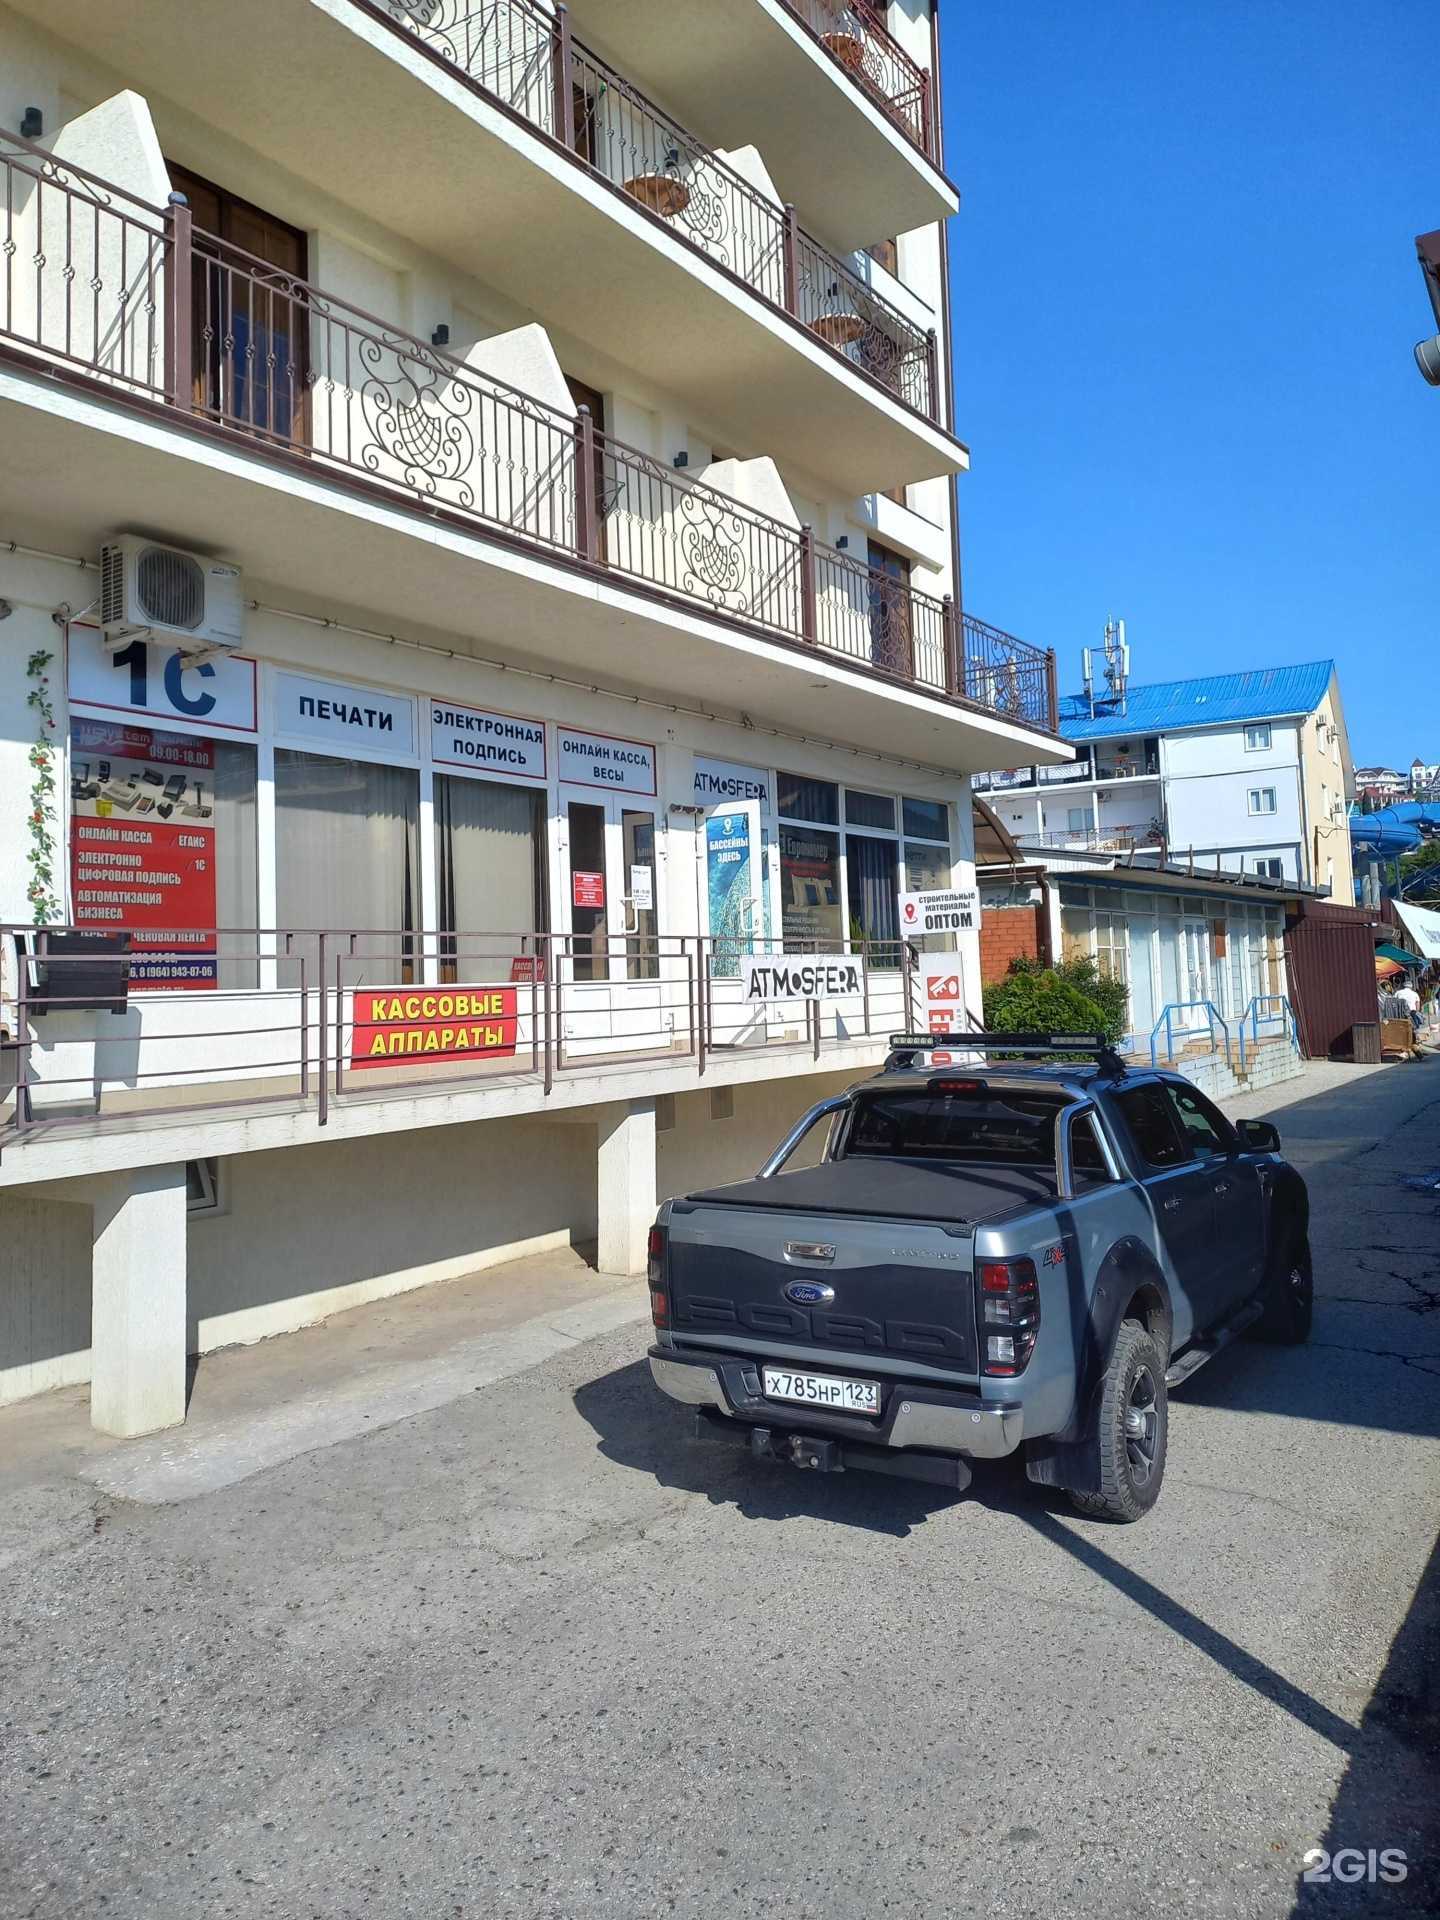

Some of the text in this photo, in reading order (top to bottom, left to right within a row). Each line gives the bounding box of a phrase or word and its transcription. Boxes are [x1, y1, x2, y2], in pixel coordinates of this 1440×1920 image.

[299, 696, 393, 731] ПЕЧАТИ
[433, 709, 543, 744] ЭЛЕКТРОННАЯ
[453, 739, 527, 765] ПОДПИСЬ
[563, 740, 651, 769] ОНЛАЙН КАССА,
[593, 766, 624, 782] ВЕСЫ
[79, 827, 153, 844] ОНЛАЙН КАССА
[178, 835, 206, 848] ЕГАИС
[709, 837, 749, 851] БАССЕЙНЫ
[78, 852, 142, 867] ЭЛЕКТРОННО
[717, 851, 741, 863] ЗДЕСЬ
[78, 869, 182, 886] ЦИФРОВАЯ ПОДПИСЬ
[78, 890, 162, 905] АВТОМАТИЗАЦИЯ
[918, 893, 976, 904] строительные
[77, 907, 124, 920] БИЗНЕСА
[925, 902, 971, 912] материалы
[925, 912, 973, 930] ОПТОМ
[372, 994, 504, 1021] КАССОВЫЕ
[369, 1026, 504, 1056] АППАРАТЫ
[676, 1294, 967, 1361] FORD
